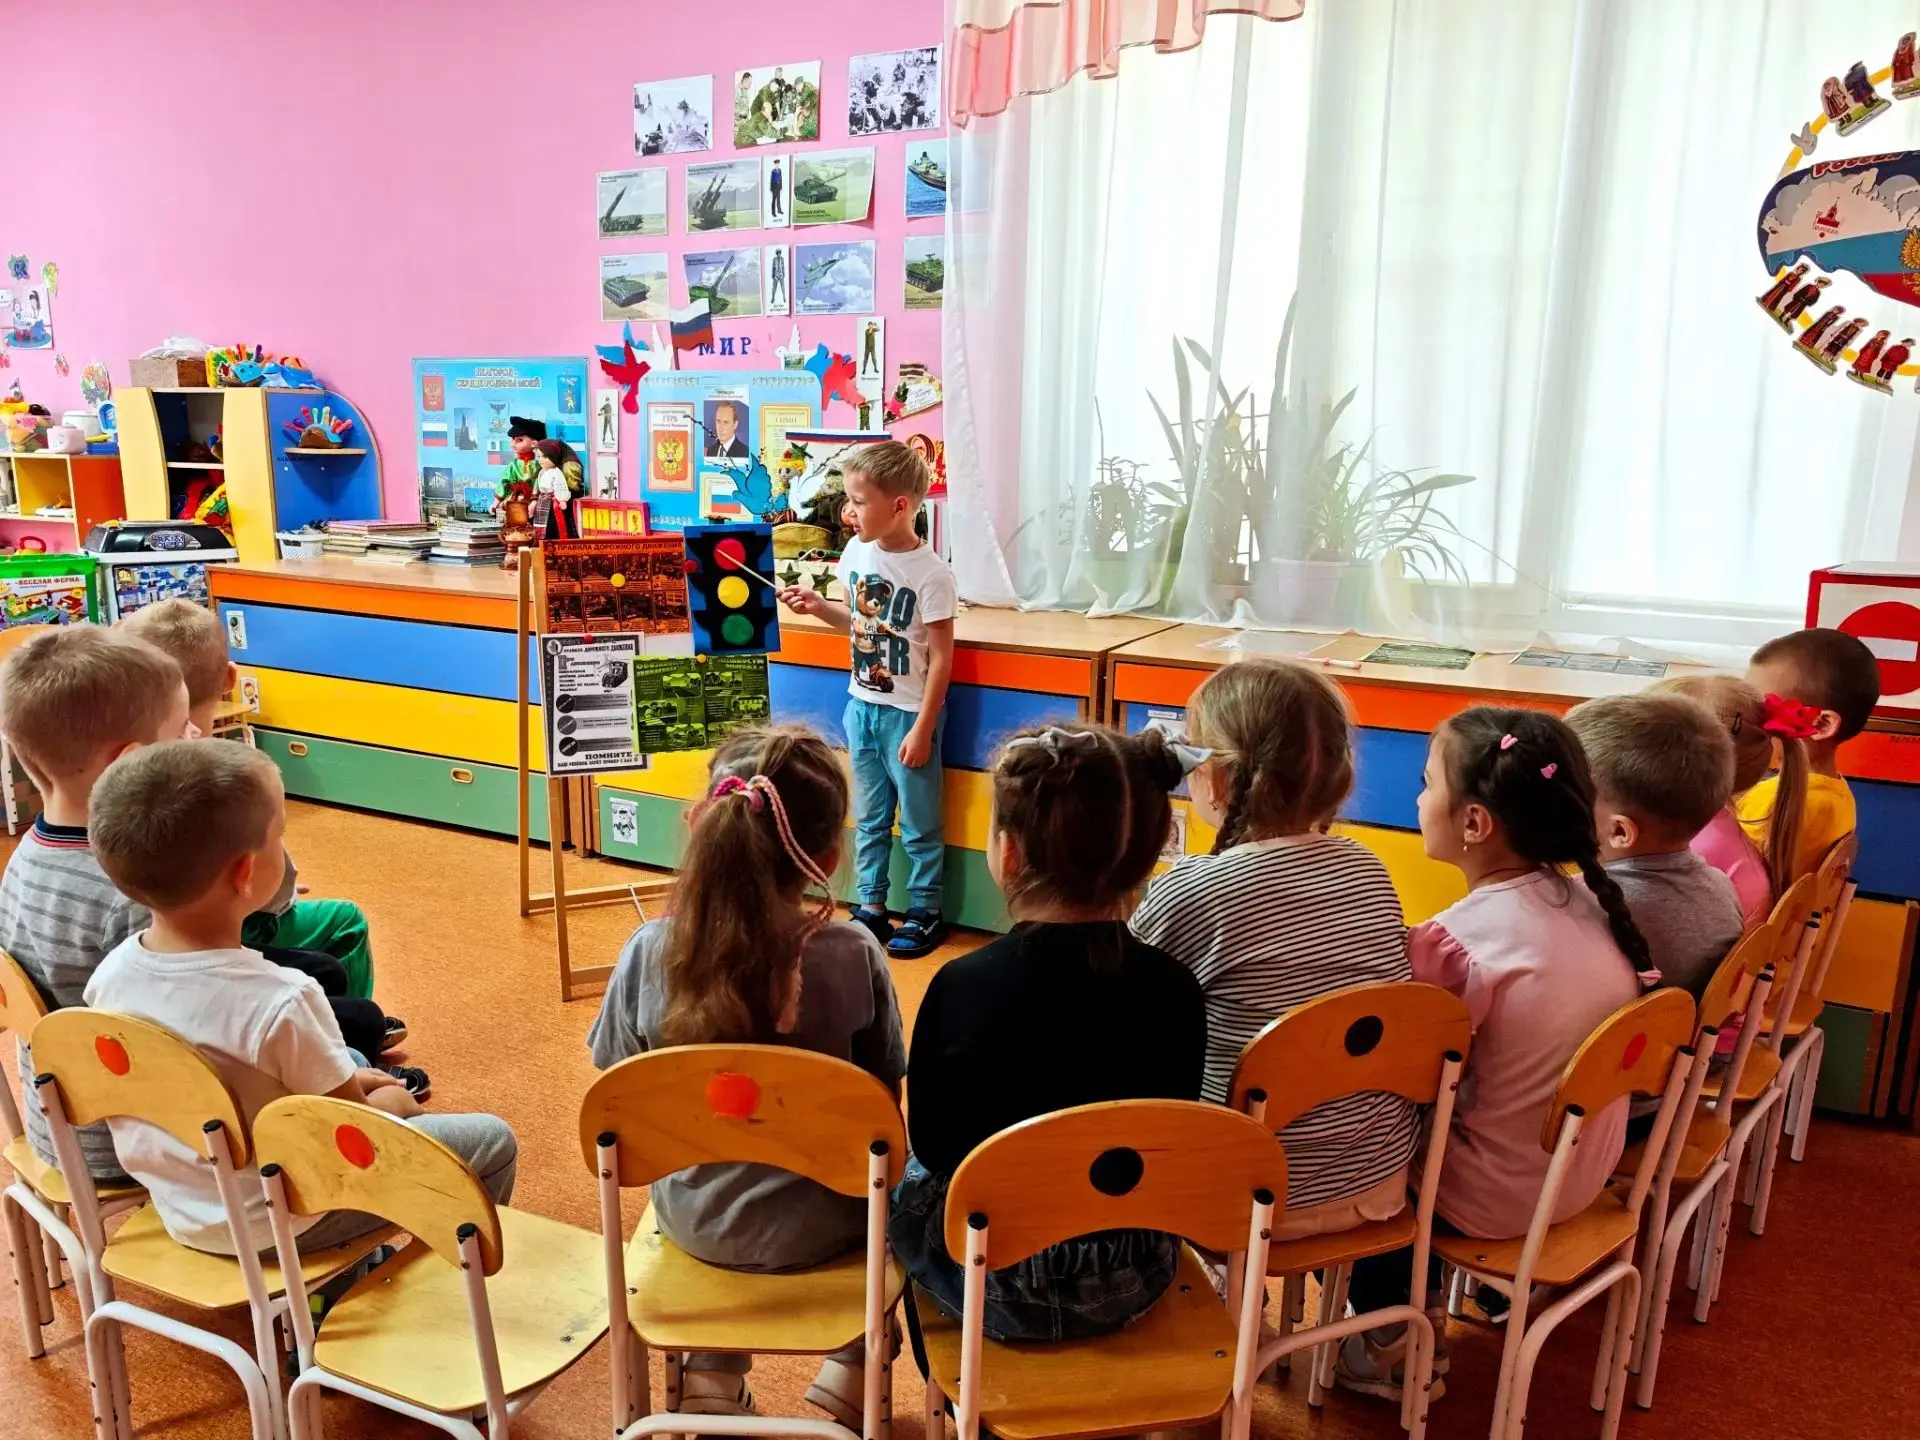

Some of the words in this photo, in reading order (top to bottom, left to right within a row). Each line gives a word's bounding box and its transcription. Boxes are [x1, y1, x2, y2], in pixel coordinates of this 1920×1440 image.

[699, 337, 751, 356] МИР
[642, 542, 682, 550] ДВИЖЕНИЯ
[585, 752, 633, 760] ПОМНИТЕ
